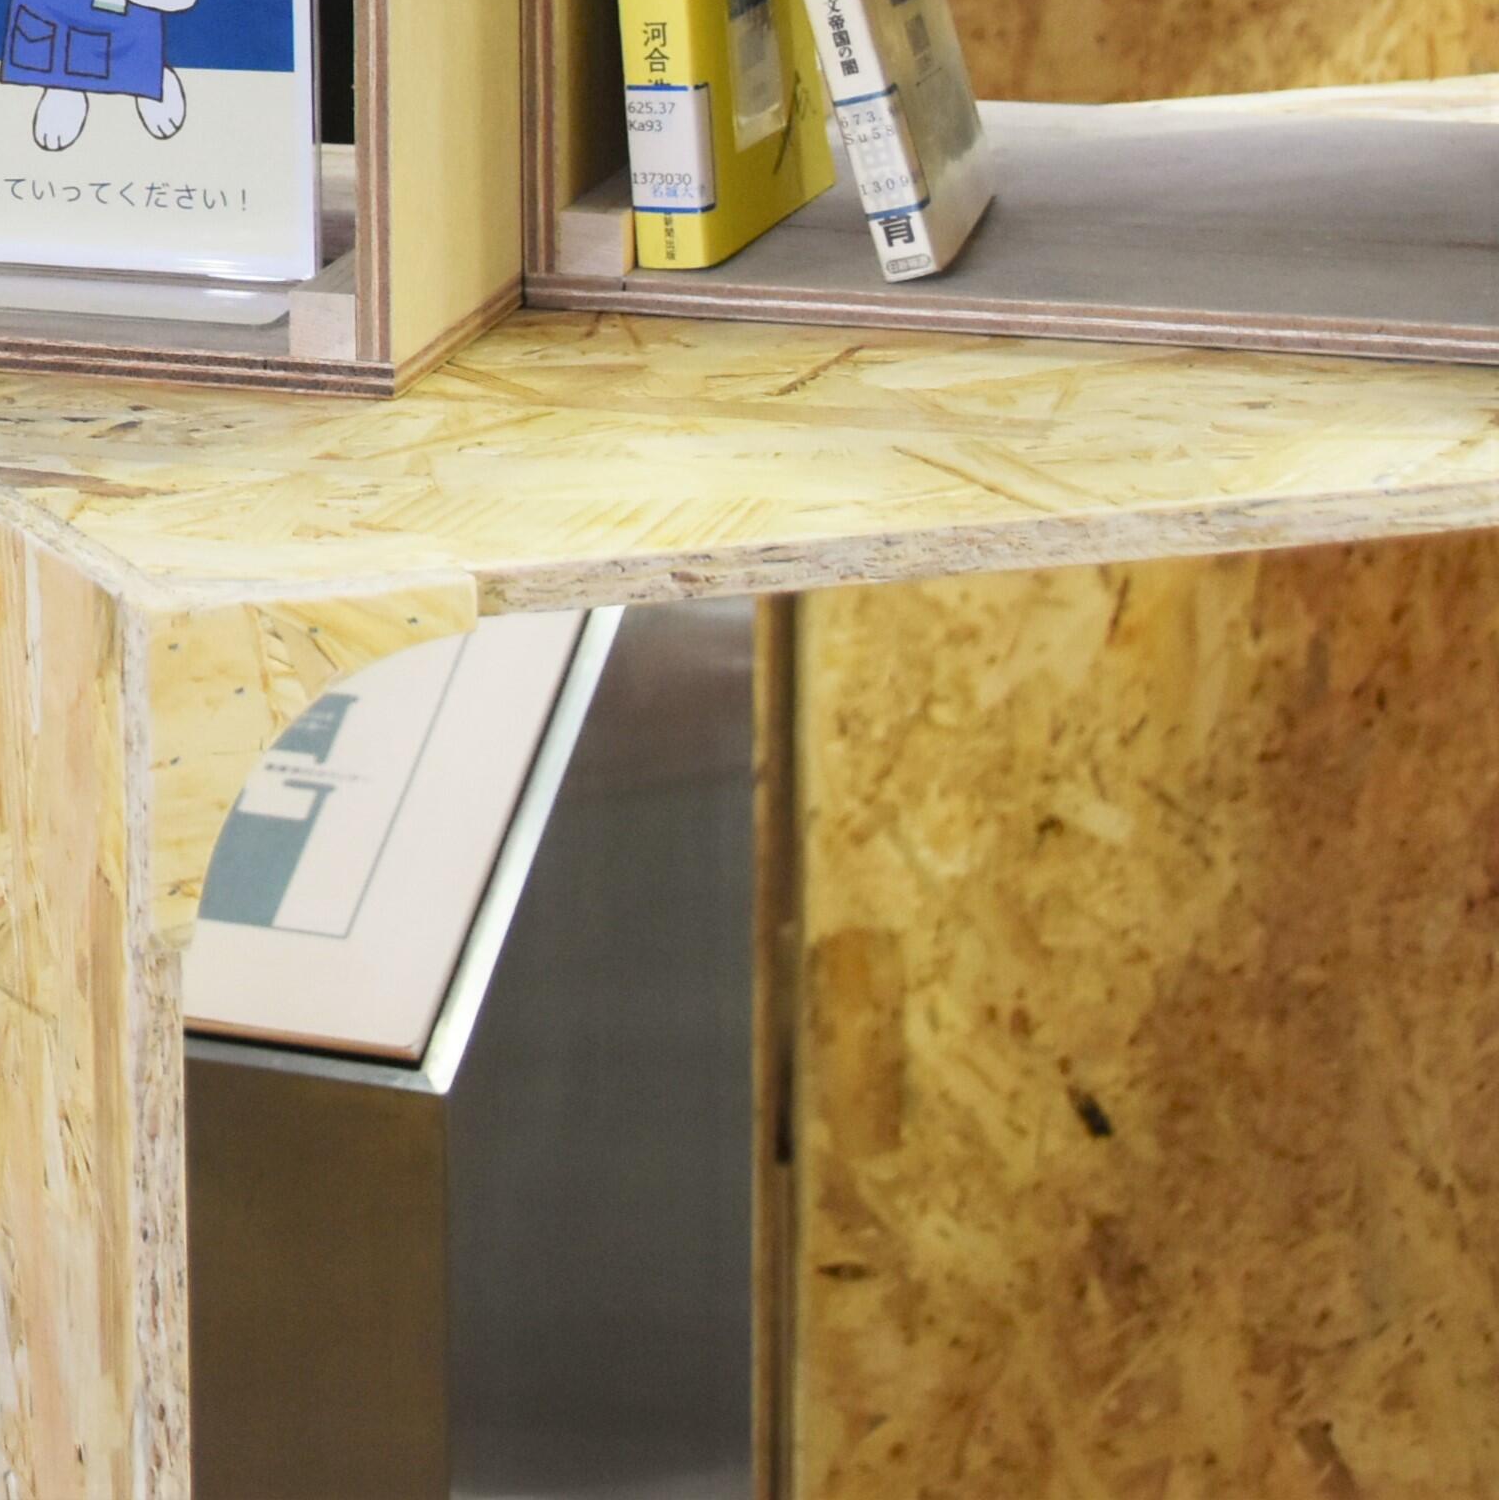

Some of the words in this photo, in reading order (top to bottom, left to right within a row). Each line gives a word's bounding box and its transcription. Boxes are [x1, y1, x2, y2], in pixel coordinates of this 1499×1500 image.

[627, 101, 676, 116] 625.37
[627, 119, 664, 133] Ka93
[631, 172, 693, 186] 1373030
